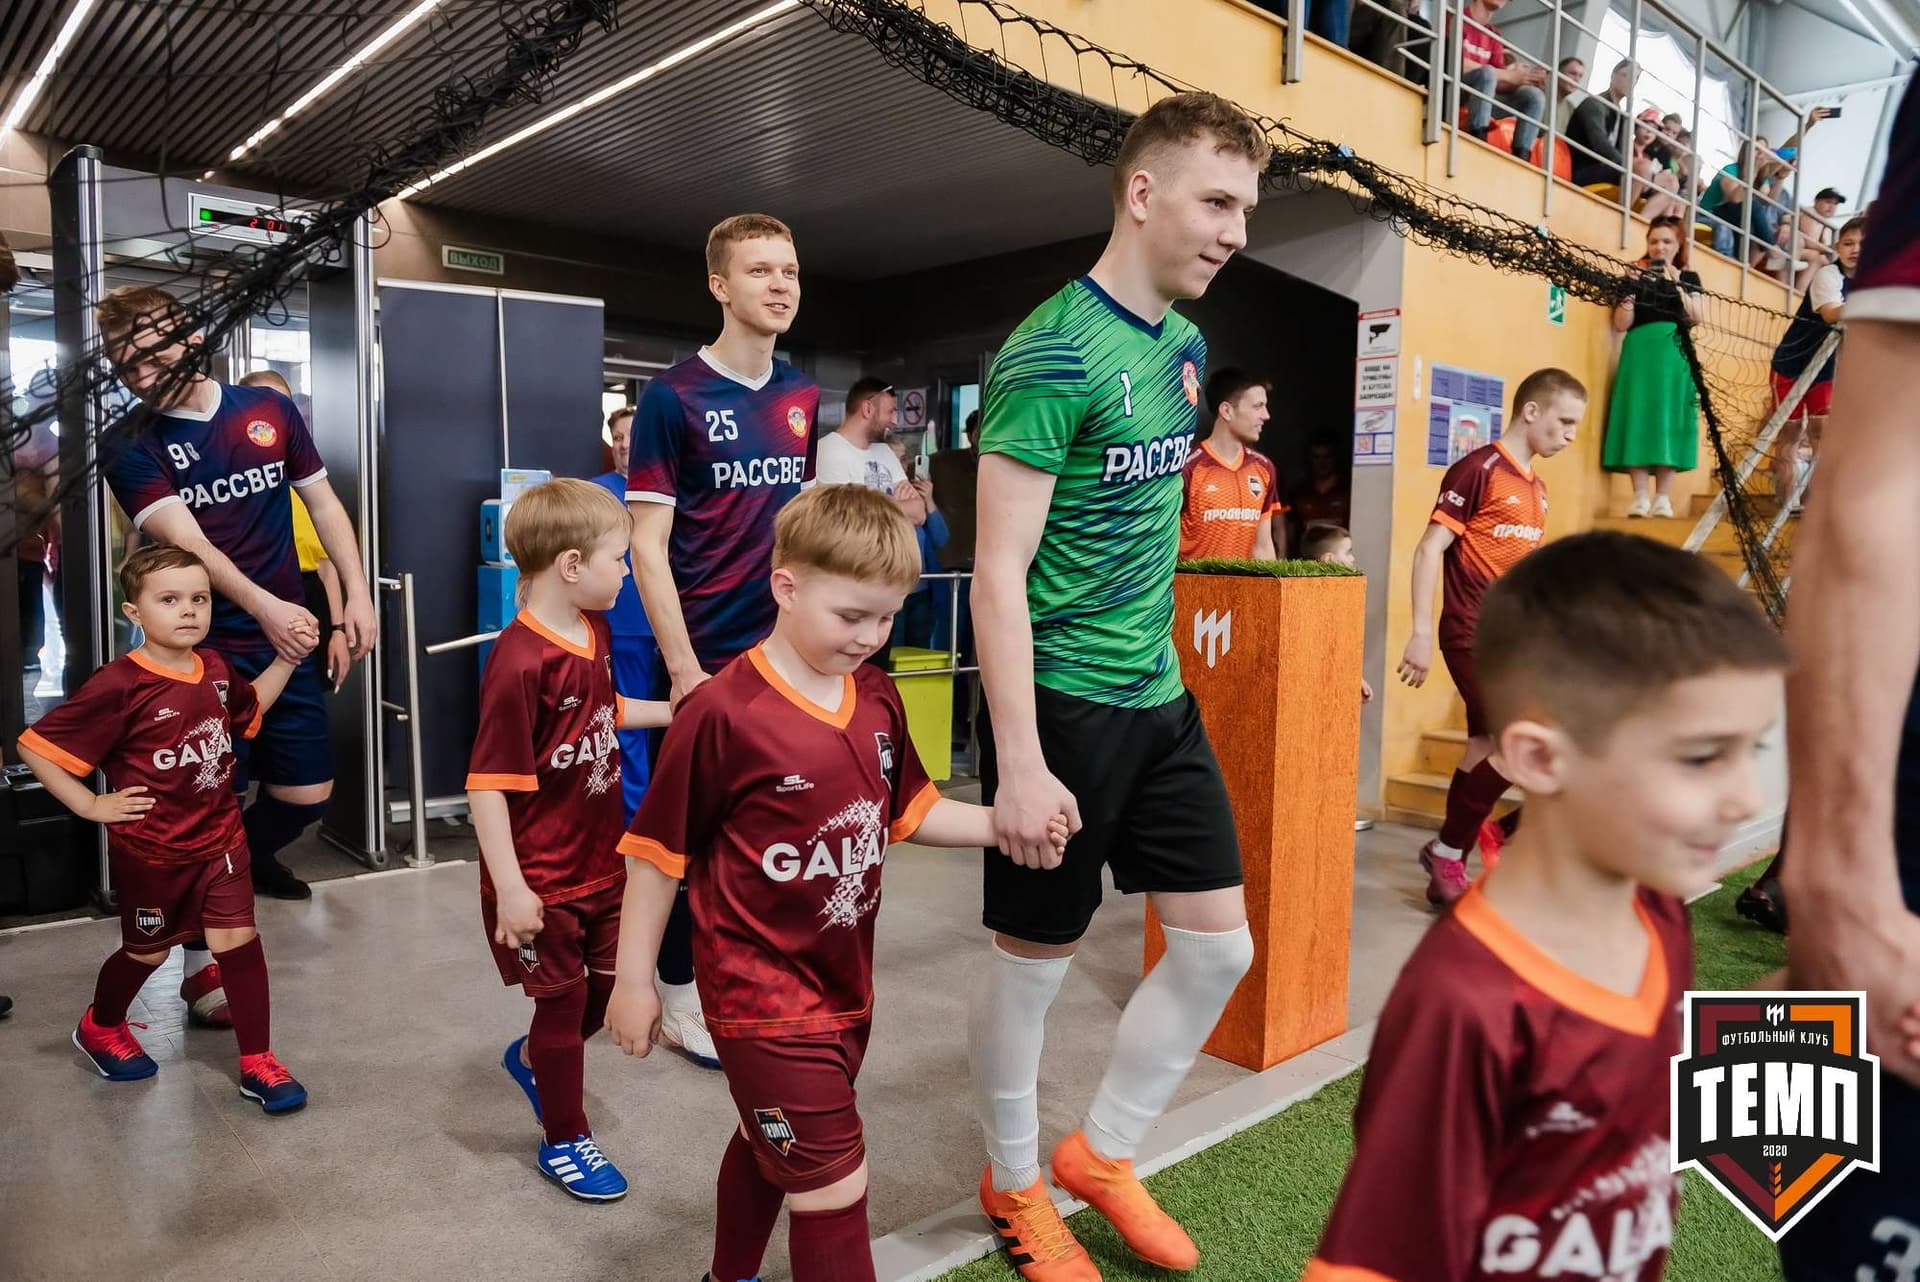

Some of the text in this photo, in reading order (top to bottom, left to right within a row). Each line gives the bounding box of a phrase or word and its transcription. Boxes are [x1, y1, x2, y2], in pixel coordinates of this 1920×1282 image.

[450, 251, 498, 269] ВЫХОД
[1120, 371, 1132, 416] 1
[705, 409, 739, 442] 25
[1103, 433, 1195, 482] РАССВЕ
[179, 460, 285, 509] РАССВЕТ
[550, 726, 620, 770] GALA
[776, 782, 815, 793] SportLife
[139, 916, 162, 927] ТЕМП
[1480, 1190, 1674, 1279] GALA
